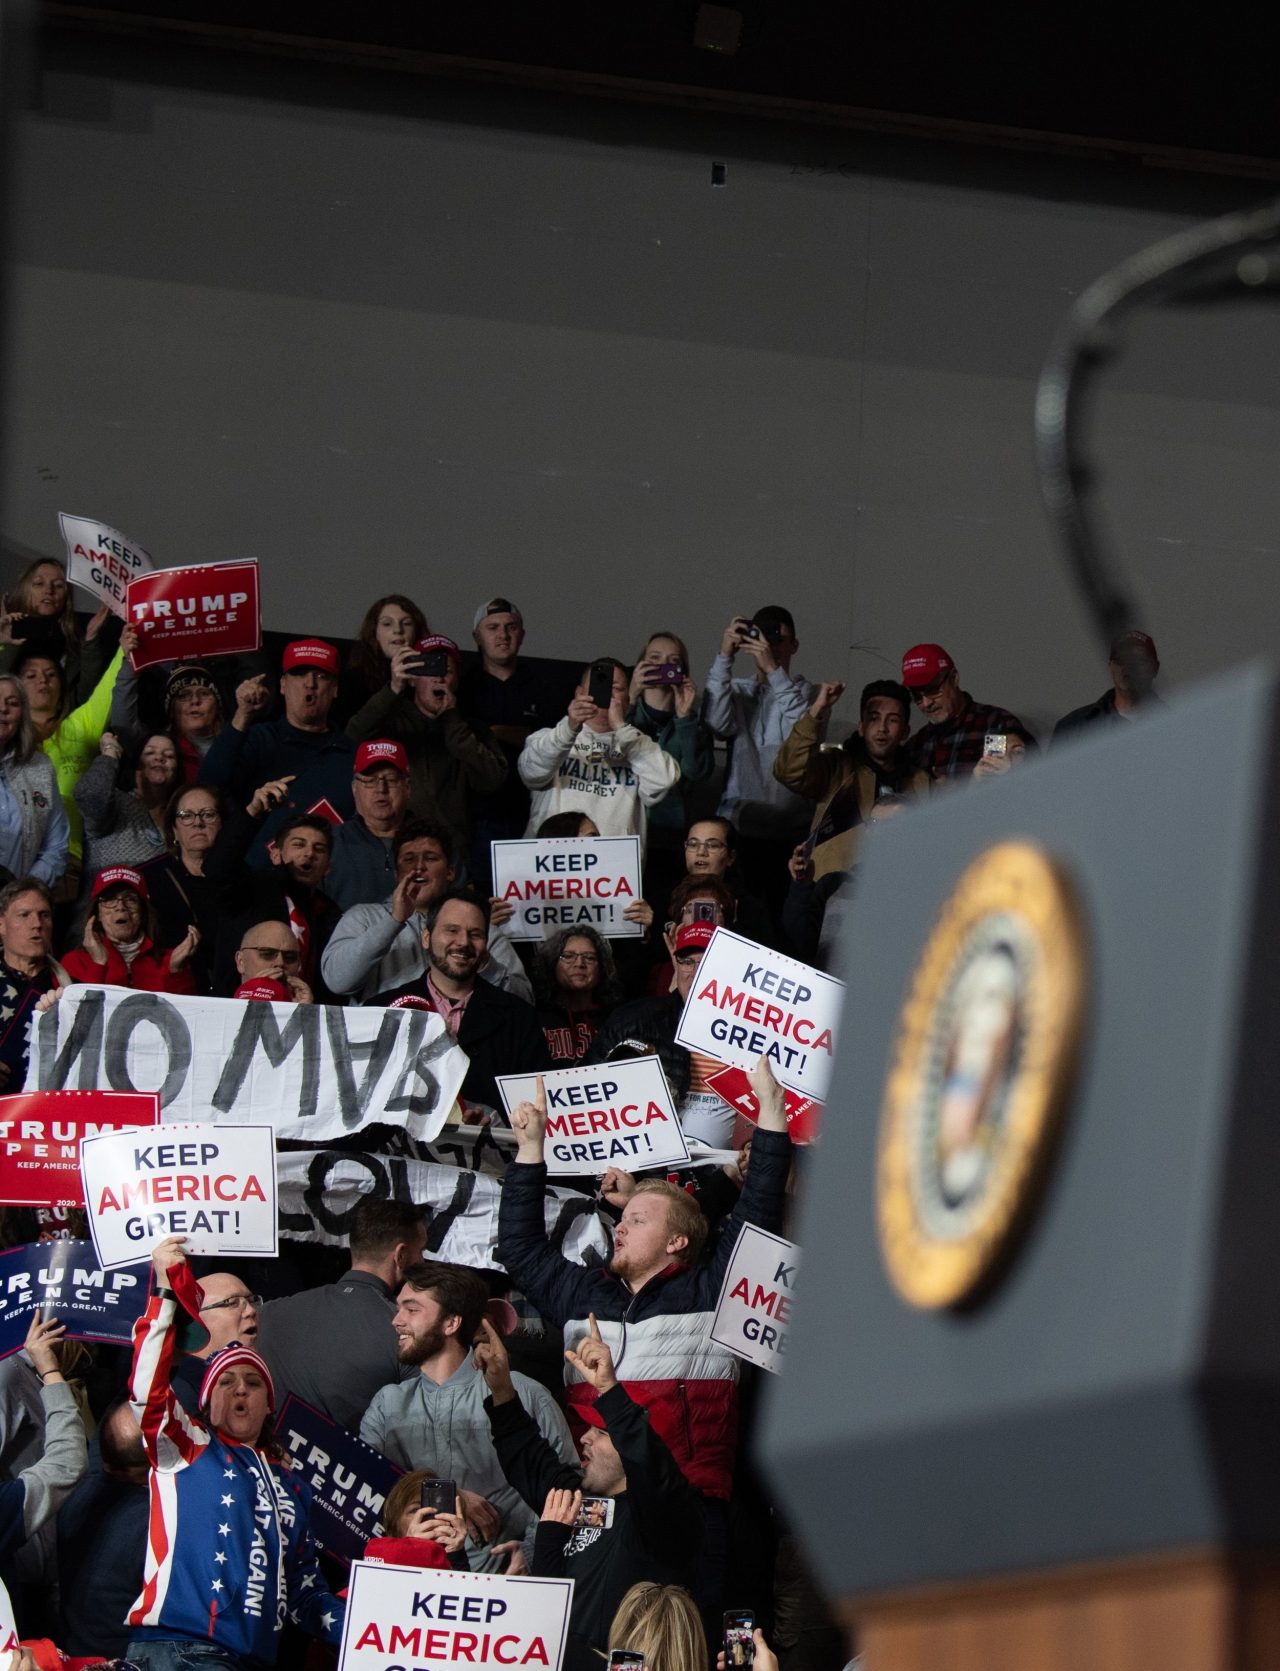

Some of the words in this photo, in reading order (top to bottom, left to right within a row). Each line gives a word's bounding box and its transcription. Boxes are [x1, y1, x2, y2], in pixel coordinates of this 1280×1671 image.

[73, 544, 135, 585] AMERI
[97, 534, 141, 568] KEEP
[132, 592, 248, 619] TRUMP
[143, 611, 238, 632] PENCE
[152, 631, 170, 639] KEEP
[171, 629, 202, 637] AMERICA
[204, 625, 230, 633] GREAT!
[559, 758, 635, 786] WALLEYE
[569, 779, 617, 797] HOCKEY
[535, 853, 598, 873] KEEP
[503, 876, 634, 901] AMERICA
[524, 905, 615, 925] GREAT!
[742, 962, 812, 1006] KEEP
[697, 979, 834, 1057] AMERICA
[710, 1018, 809, 1076] GREAT!
[547, 1081, 619, 1108] KEEP
[702, 1095, 719, 1105] BETSY
[0, 1121, 142, 1141] TRUM
[545, 1101, 668, 1138] MERICA
[6, 1142, 76, 1159] PEN
[134, 1143, 219, 1171] KEEP
[553, 1132, 655, 1163] GREAT!
[17, 1161, 40, 1169] KEEP
[97, 1174, 267, 1215] AMERICA
[125, 1210, 240, 1241] GREAT!
[0, 1267, 138, 1294] RUMP
[4, 1307, 25, 1321] KEEP
[26, 1301, 69, 1311] AMERICA
[71, 1303, 107, 1313] GREAT!
[288, 1429, 386, 1515] TRUM
[312, 1494, 345, 1523] AMERICA
[313, 1540, 325, 1550] 20
[243, 1527, 268, 1618] AGAIN!
[411, 1592, 508, 1623] KEEP
[354, 1622, 550, 1666] AMERICA
